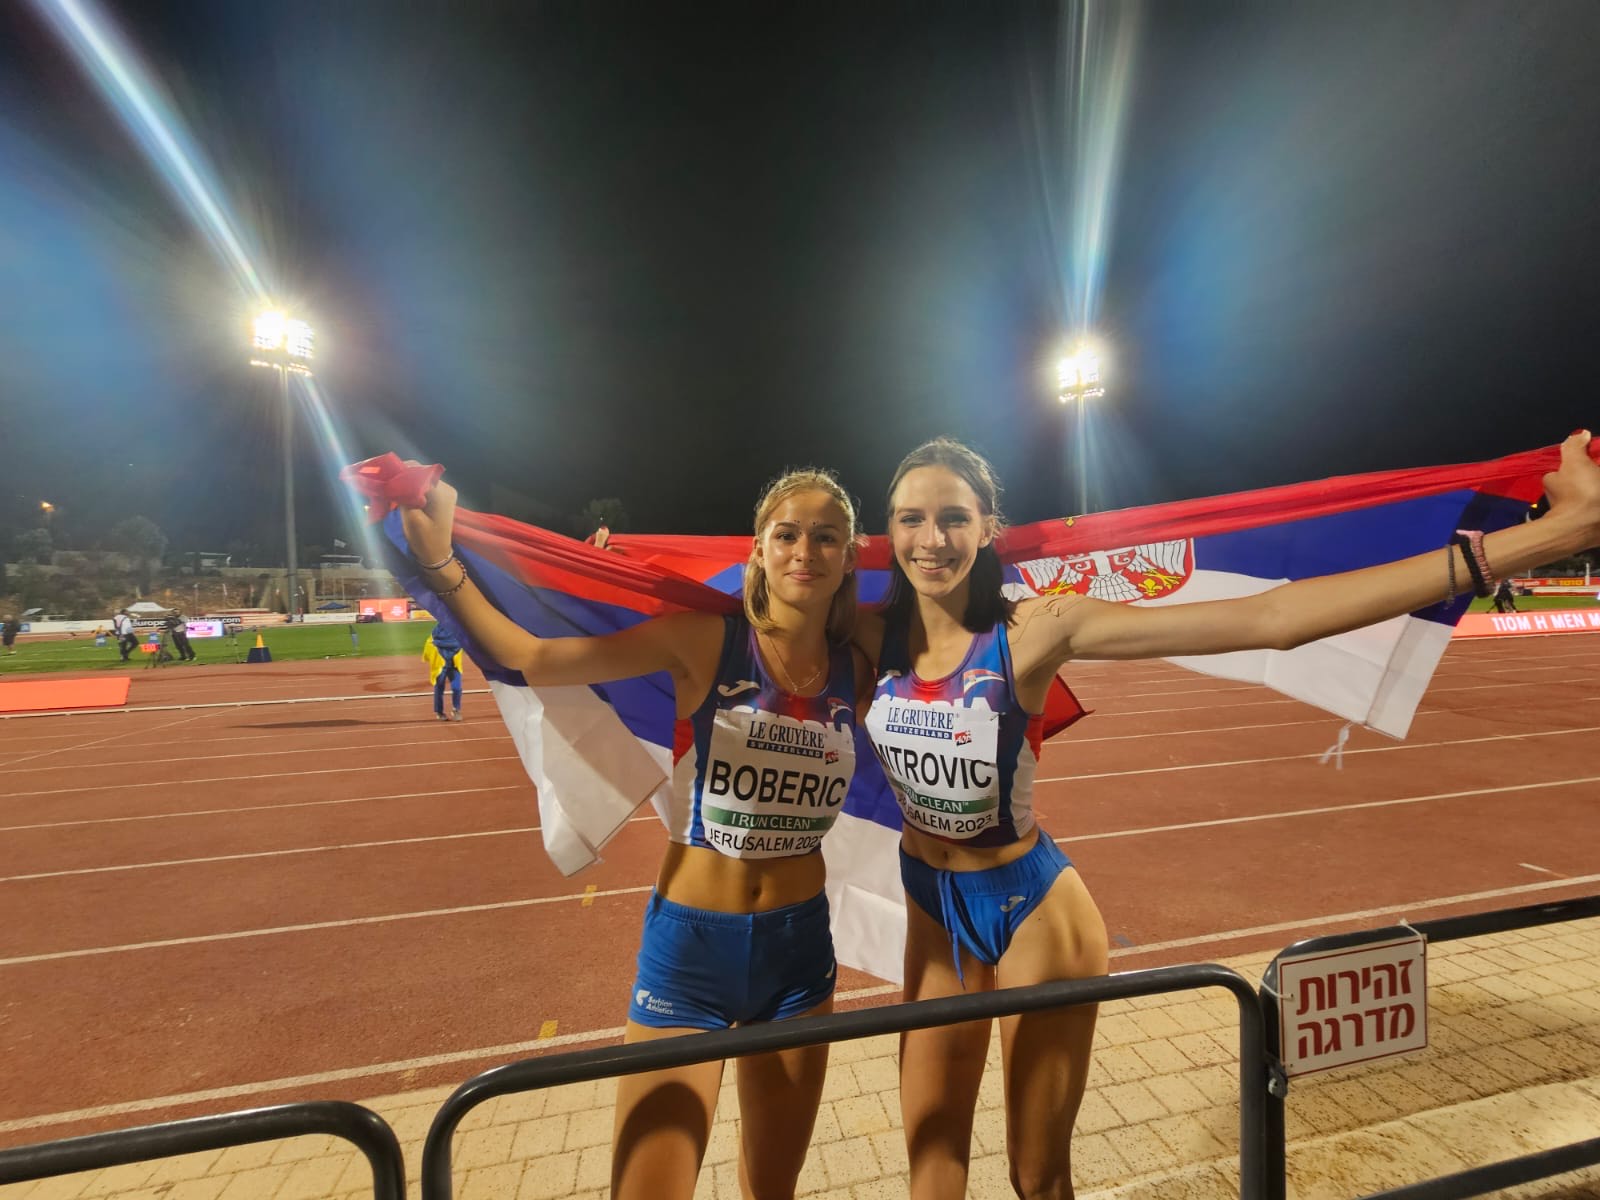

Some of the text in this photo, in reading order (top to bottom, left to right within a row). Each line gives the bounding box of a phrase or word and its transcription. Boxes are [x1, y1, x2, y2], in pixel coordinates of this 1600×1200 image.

[1491, 615, 1531, 631] 110M
[1534, 615, 1548, 630] H
[1550, 613, 1586, 629] MEN
[888, 707, 954, 729] LE GRUYÈRE
[749, 721, 825, 749] LE GRUYÈRE
[887, 725, 951, 740] SWITZERLAND
[750, 741, 821, 758] SWITZERLAND
[709, 760, 846, 807] BOBERIC
[731, 813, 737, 825] I
[738, 813, 768, 828] RUN
[710, 828, 794, 851] JERUSALEM
[1296, 959, 1414, 1015] זהירות
[1297, 1003, 1415, 1059] מדרגה
